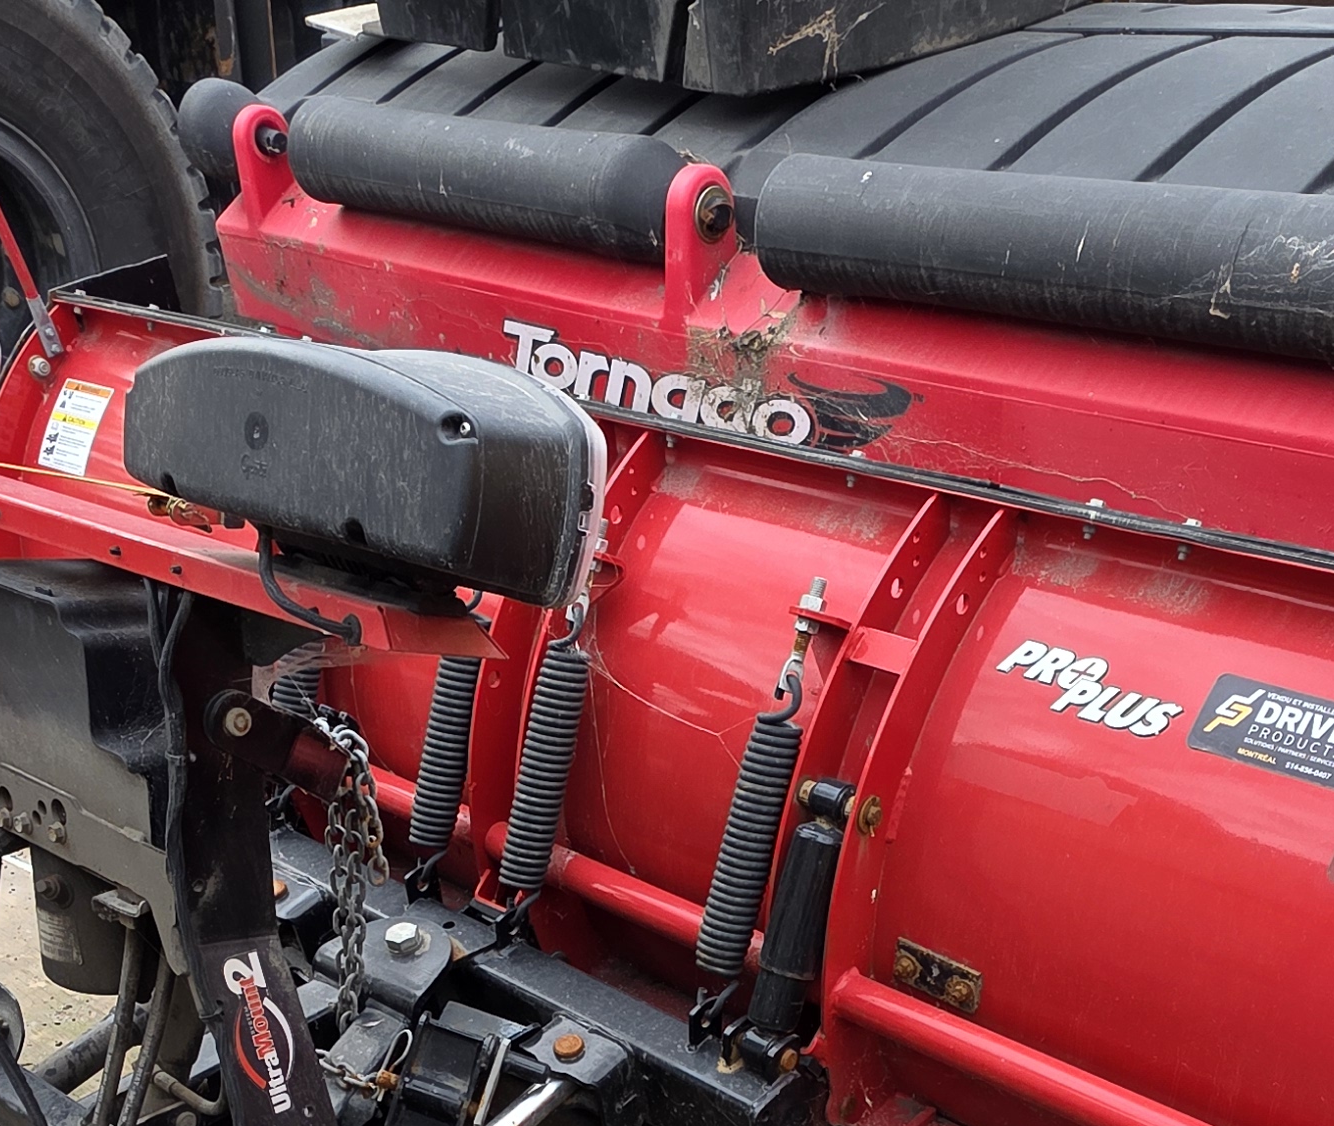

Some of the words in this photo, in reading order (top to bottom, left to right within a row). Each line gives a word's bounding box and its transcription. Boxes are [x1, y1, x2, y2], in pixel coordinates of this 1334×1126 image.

[995, 639, 1109, 691] PRO
[1049, 678, 1184, 738] PLUS
[1267, 692, 1292, 704] VENDU
[1237, 747, 1277, 765] MONTRÉAL
[1243, 737, 1275, 750] SOLUTIONS
[1277, 746, 1307, 759] PARTNERS
[238, 975, 292, 1115] UltraMount
